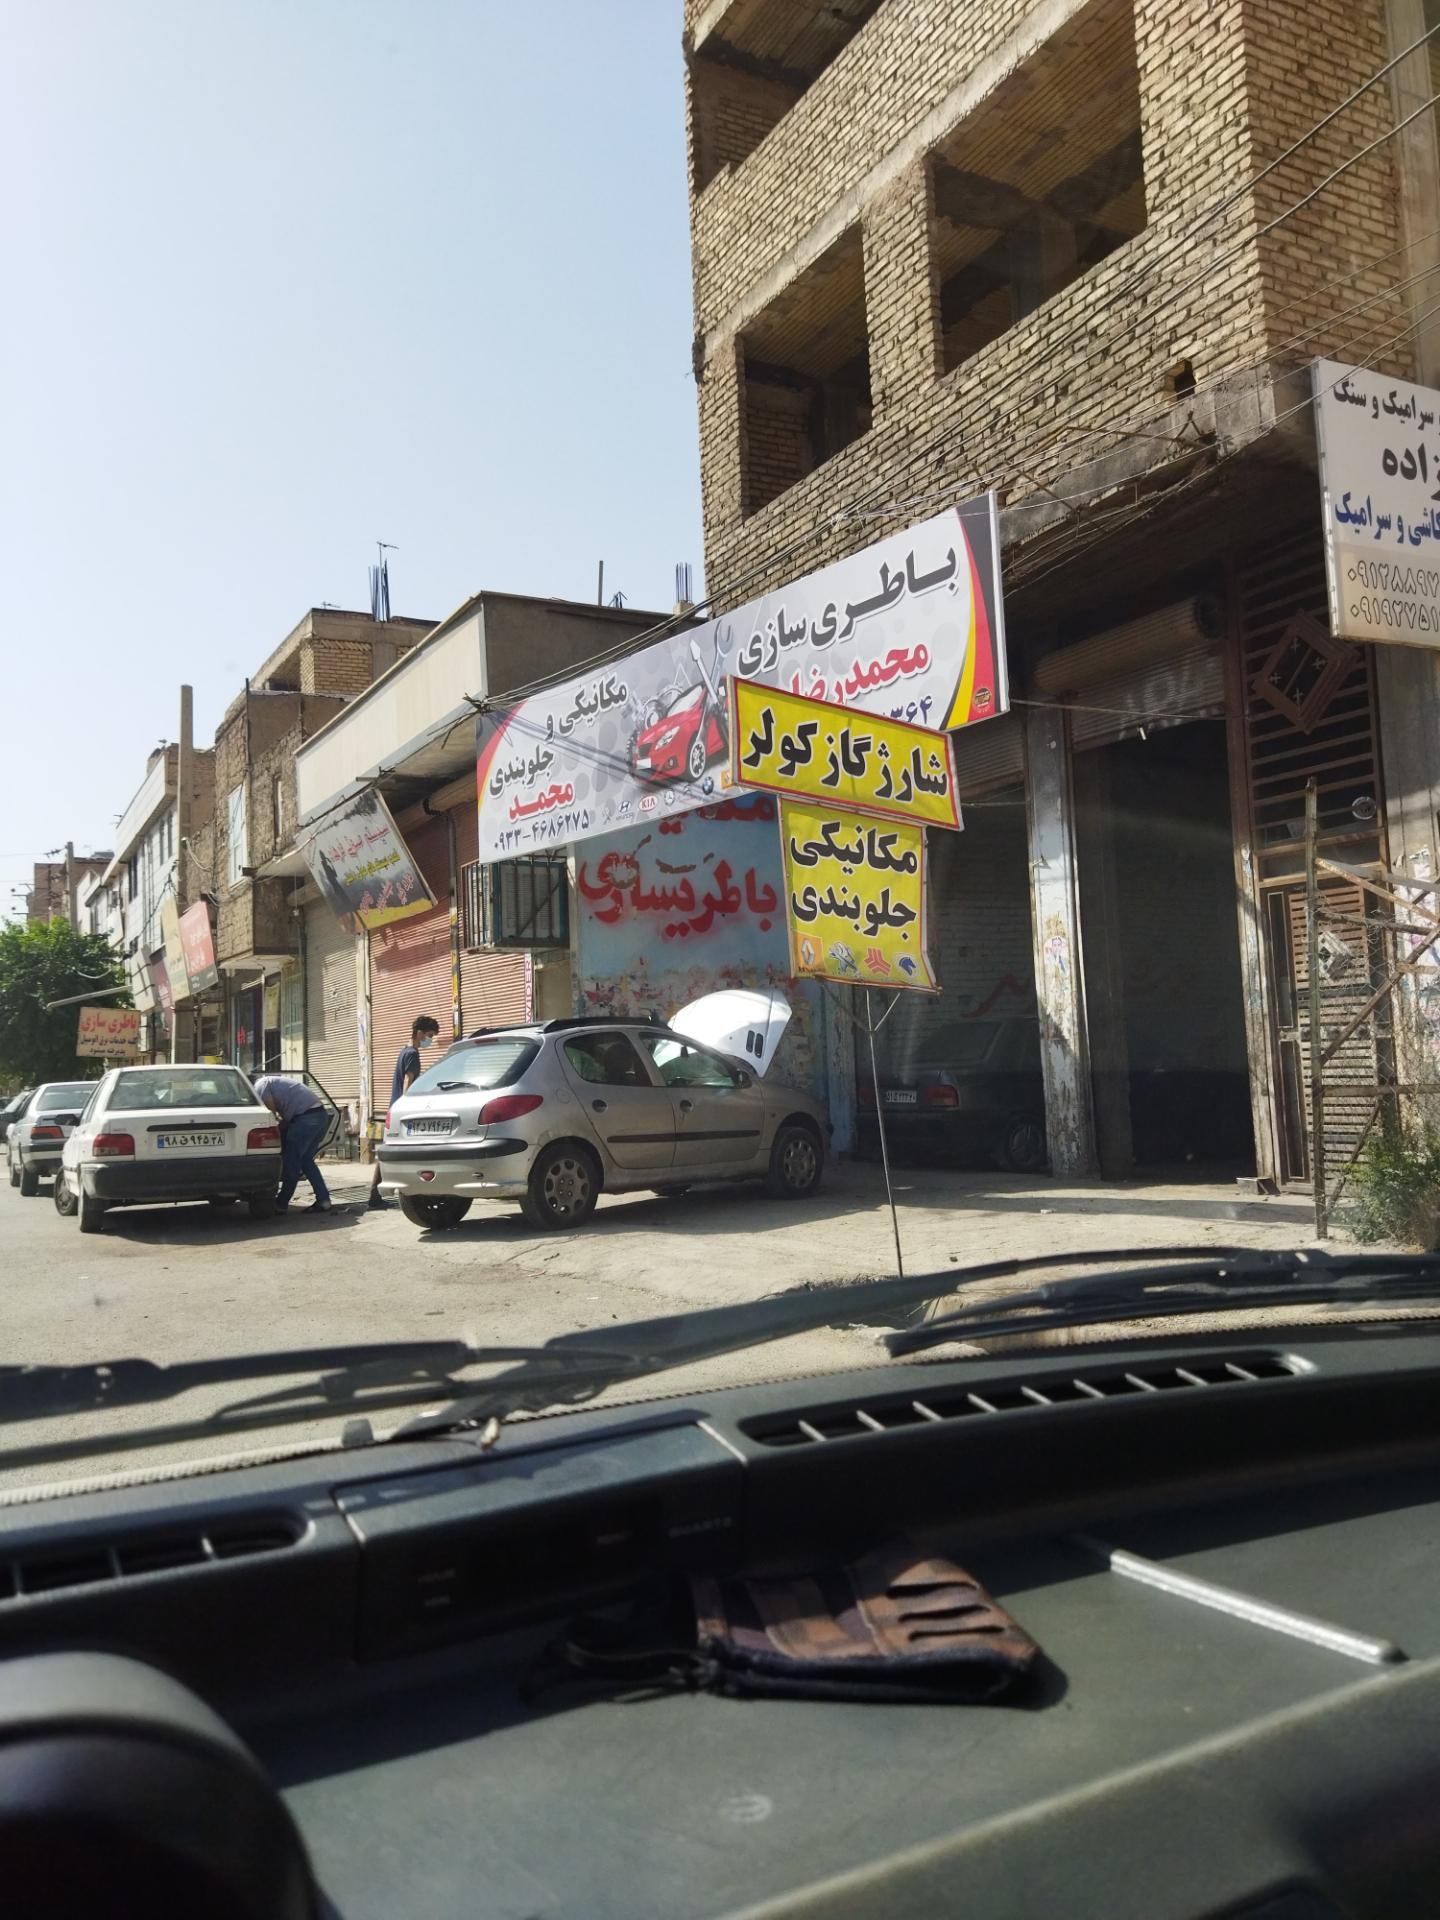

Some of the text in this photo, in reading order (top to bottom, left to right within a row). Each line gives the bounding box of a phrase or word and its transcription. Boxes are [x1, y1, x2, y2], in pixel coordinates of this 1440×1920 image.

[1371, 395, 1379, 420] و
[1397, 514, 1404, 544] و
[738, 547, 956, 675] باطری سازی
[545, 677, 628, 741] مکانیکی و
[882, 695, 933, 725] ۳۶۴
[489, 745, 554, 796] جلوبندی
[742, 708, 949, 801] شارژ گاز کولر
[508, 782, 575, 820] محمد
[641, 798, 657, 810] KIA
[790, 822, 919, 876] مکانیکی
[792, 885, 918, 941] جلوبندی
